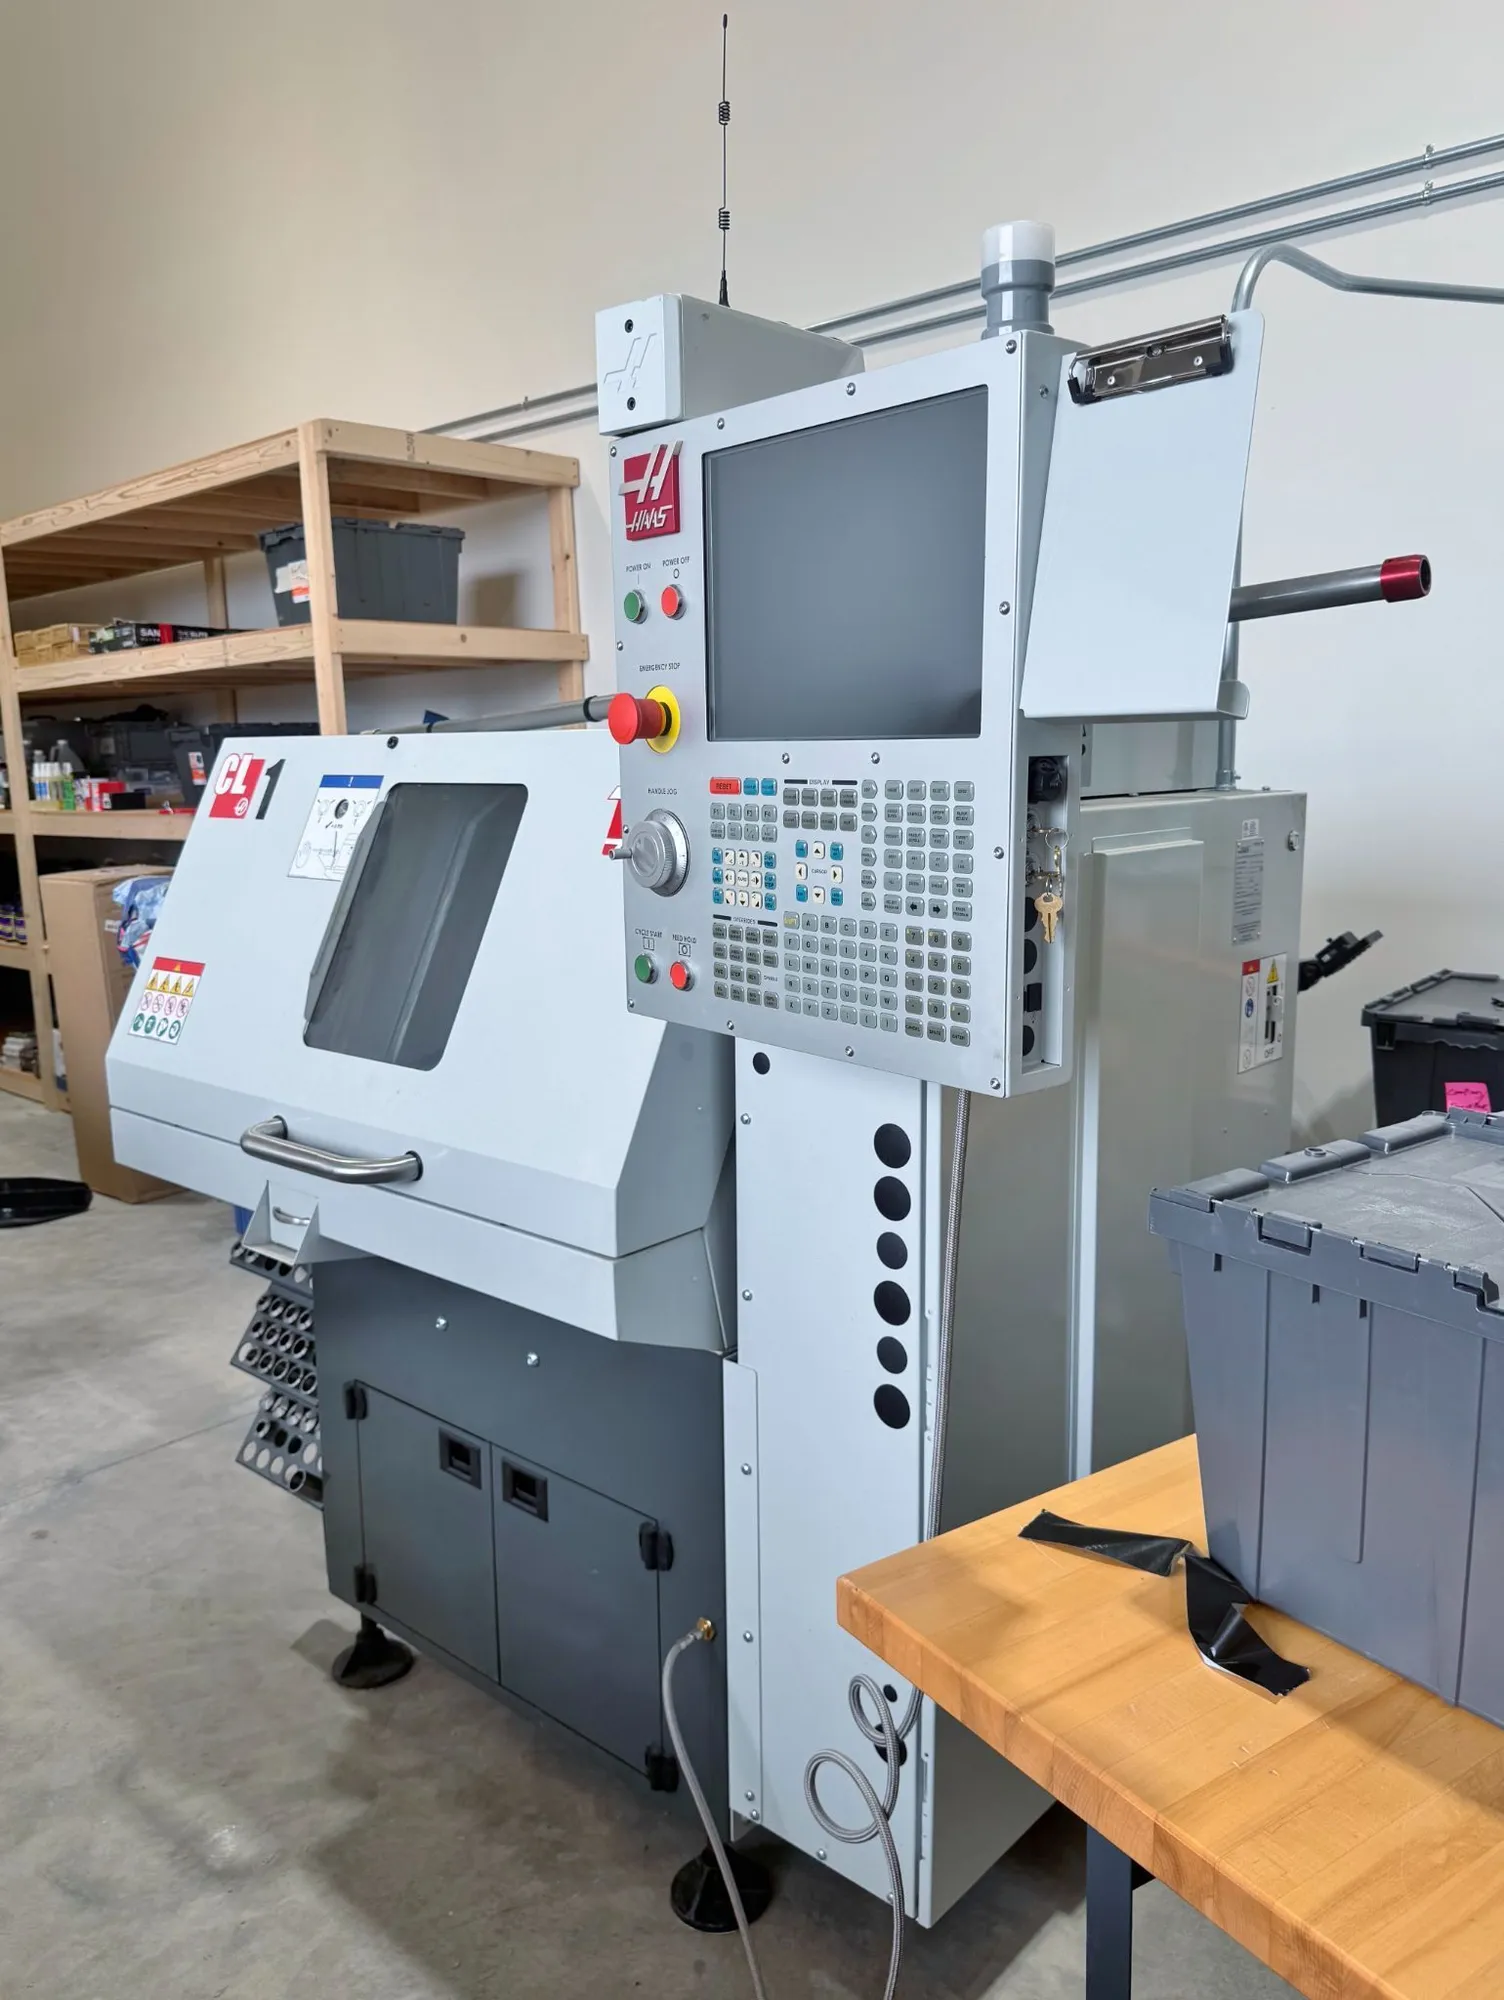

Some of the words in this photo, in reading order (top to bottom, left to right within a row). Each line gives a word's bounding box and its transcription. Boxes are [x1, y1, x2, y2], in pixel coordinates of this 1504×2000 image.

[626, 505, 672, 532] HAAS
[662, 558, 680, 567] POWER
[681, 556, 690, 564] OFF
[639, 664, 668, 672] EMERGENCY
[668, 662, 681, 671] STOP
[215, 753, 254, 795] CL
[255, 759, 286, 820] 1
[647, 787, 666, 795] HANDLE
